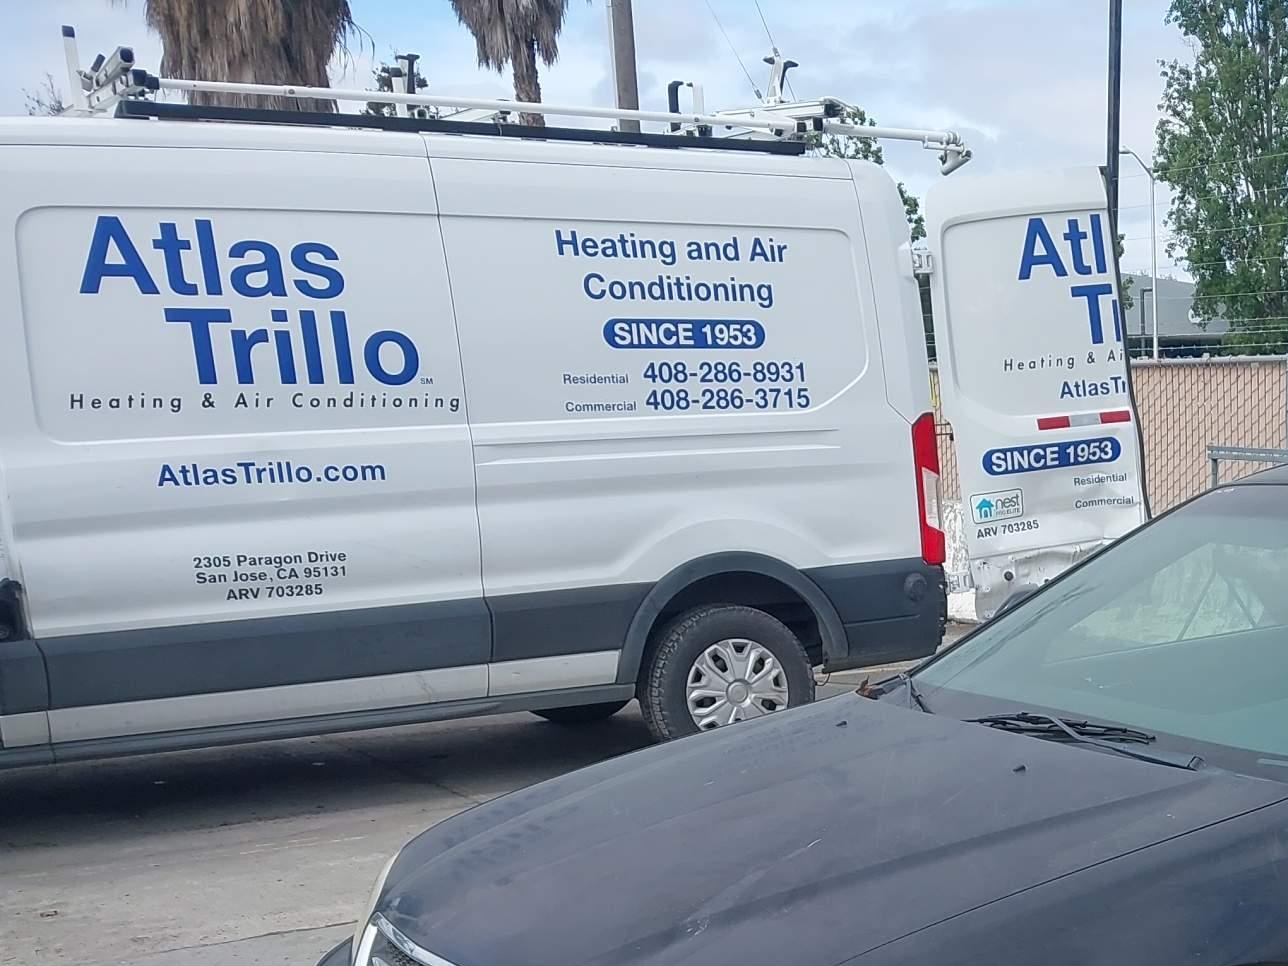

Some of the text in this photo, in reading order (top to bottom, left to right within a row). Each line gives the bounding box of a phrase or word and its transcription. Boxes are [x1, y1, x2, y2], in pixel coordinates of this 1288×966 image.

[79, 216, 345, 298] Atlas
[555, 229, 787, 265] Heating and Air
[1018, 214, 1107, 280] Atl
[583, 273, 774, 308] Conditioning
[614, 323, 756, 345] SINCE 1953
[164, 308, 419, 385] Trillo
[1004, 354, 1074, 371] Heating
[1087, 352, 1095, 364] &
[563, 362, 806, 385] Residential 408-286-8931
[70, 392, 461, 412] Heating & Air Conditioning
[565, 388, 810, 413] Commercial 408-286-3715
[991, 441, 1113, 472] SINCE 1953
[158, 462, 386, 487] AtlasTrillo.com
[1073, 473, 1127, 486] Residential
[996, 494, 1019, 510] nest
[1075, 496, 1134, 509] Commercial
[977, 520, 1039, 539] ARV 703285
[193, 550, 347, 569] 2305 Paragon Drive
[196, 565, 347, 584] San Jose, CA 95131
[226, 584, 323, 601] ARV 703285
